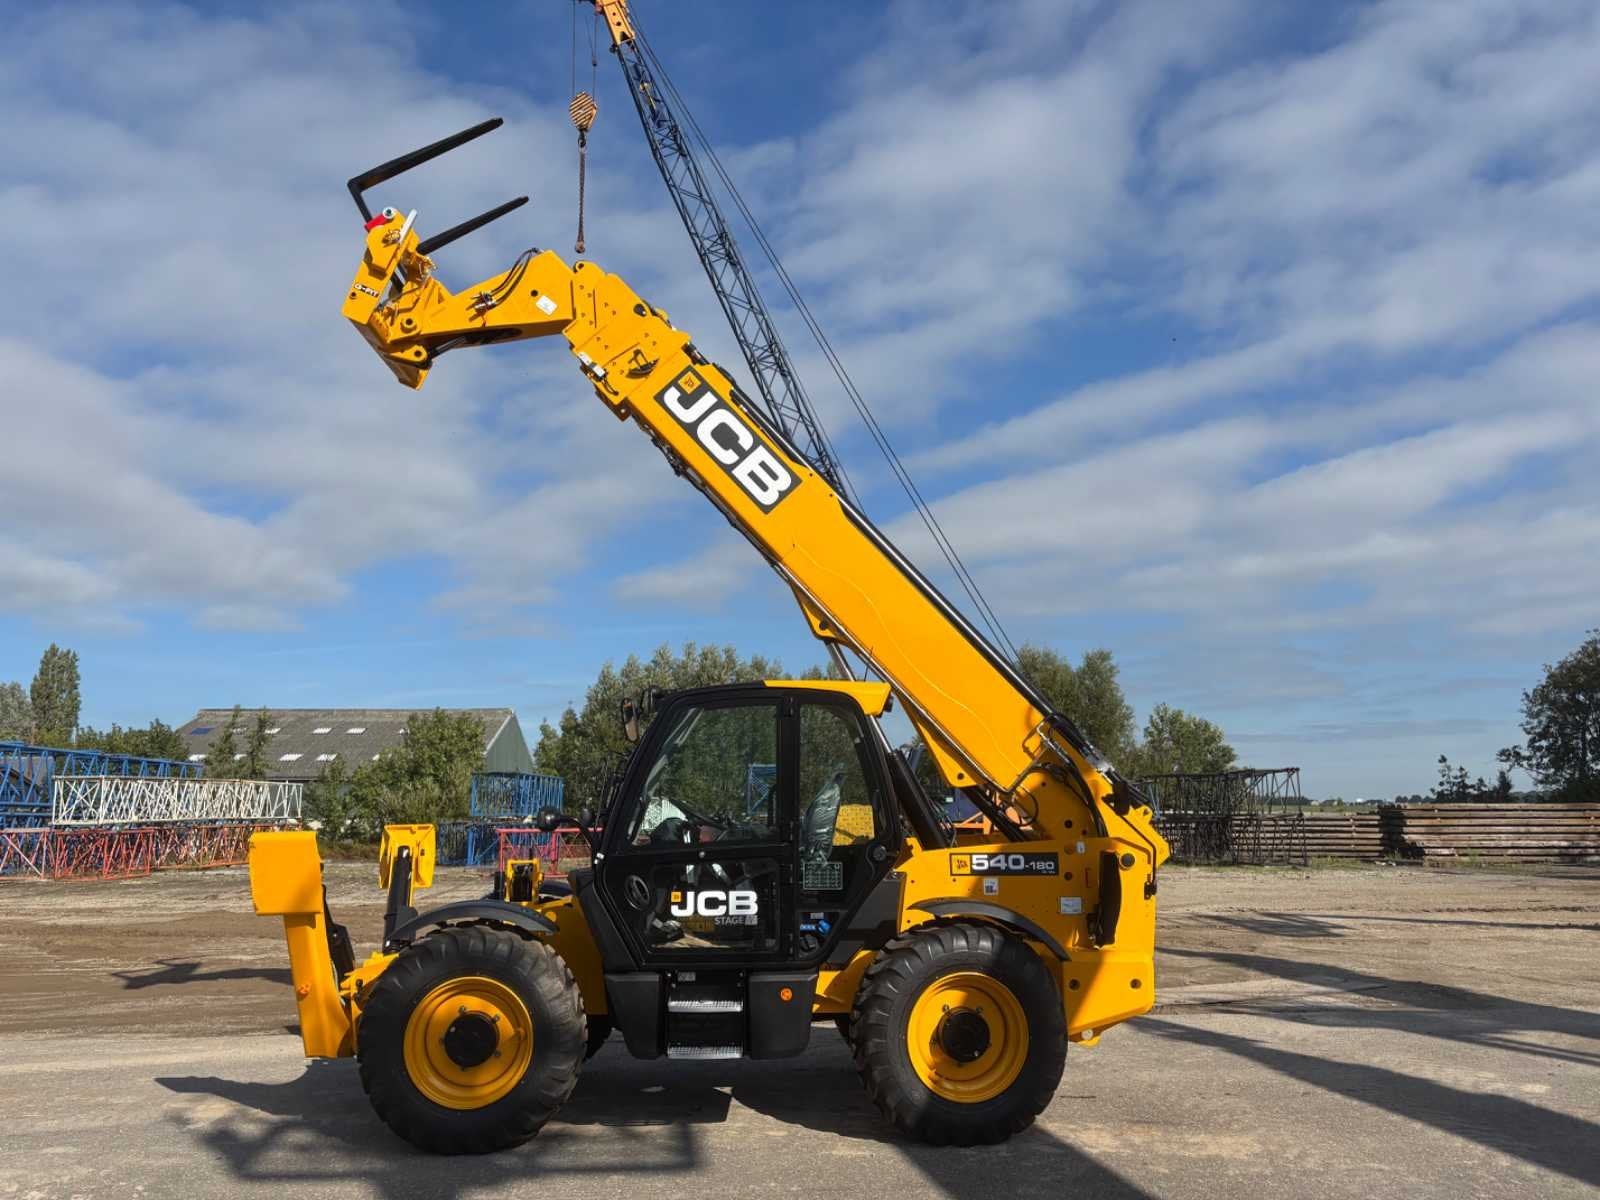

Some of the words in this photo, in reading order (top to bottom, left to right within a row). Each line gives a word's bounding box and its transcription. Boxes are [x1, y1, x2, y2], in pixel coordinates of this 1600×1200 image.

[663, 385, 792, 506] JCB
[670, 890, 759, 917] JCB
[714, 916, 744, 926] STAGE
